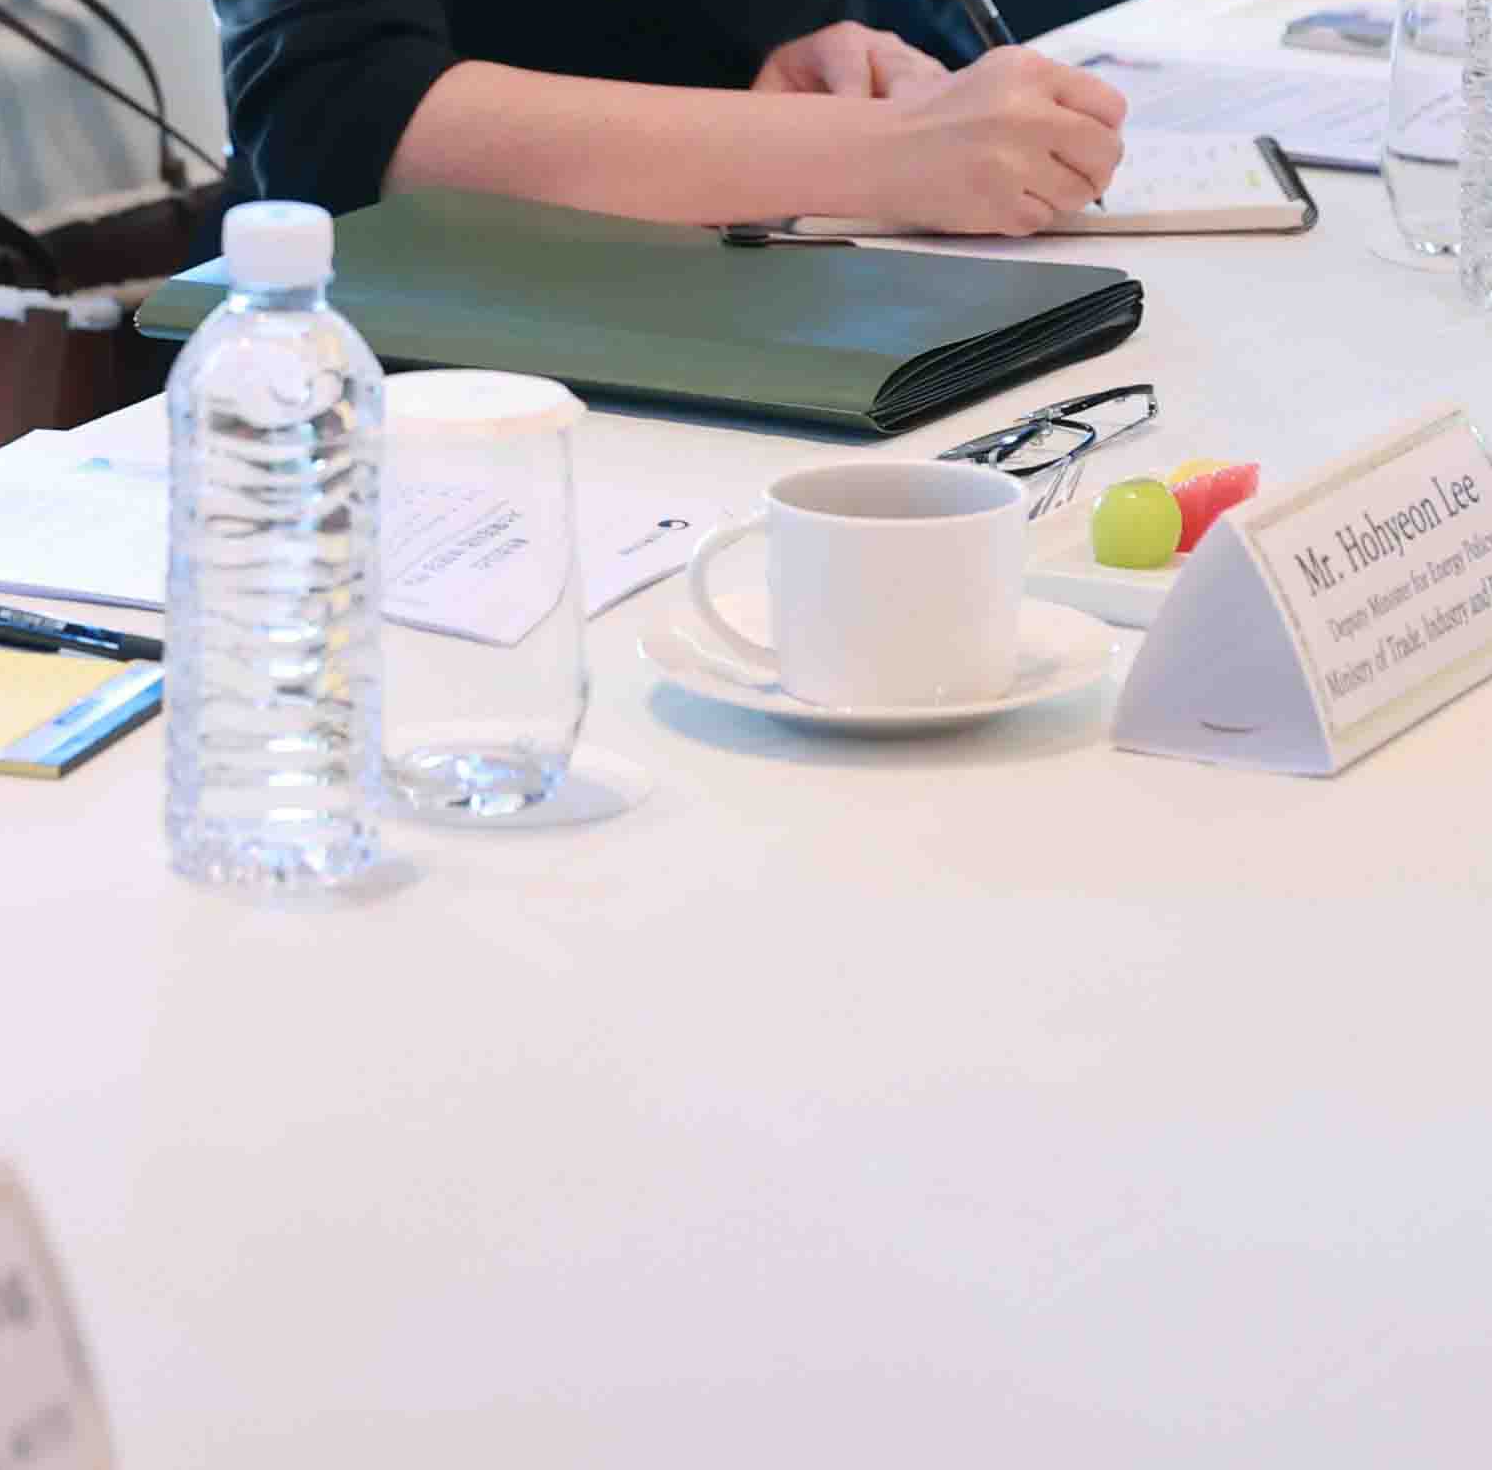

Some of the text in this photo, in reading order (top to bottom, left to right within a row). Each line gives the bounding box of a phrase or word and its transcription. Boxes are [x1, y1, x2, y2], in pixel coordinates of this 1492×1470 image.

[1293, 474, 1480, 598] Mr. Hohyeon Lee
[1326, 607, 1369, 643] Deputy
[1366, 582, 1413, 620] Minister
[1409, 569, 1430, 593] for
[1425, 553, 1466, 584] Energy
[1374, 637, 1389, 672] of
[1420, 602, 1470, 642] Industry
[1468, 578, 1492, 614] and
